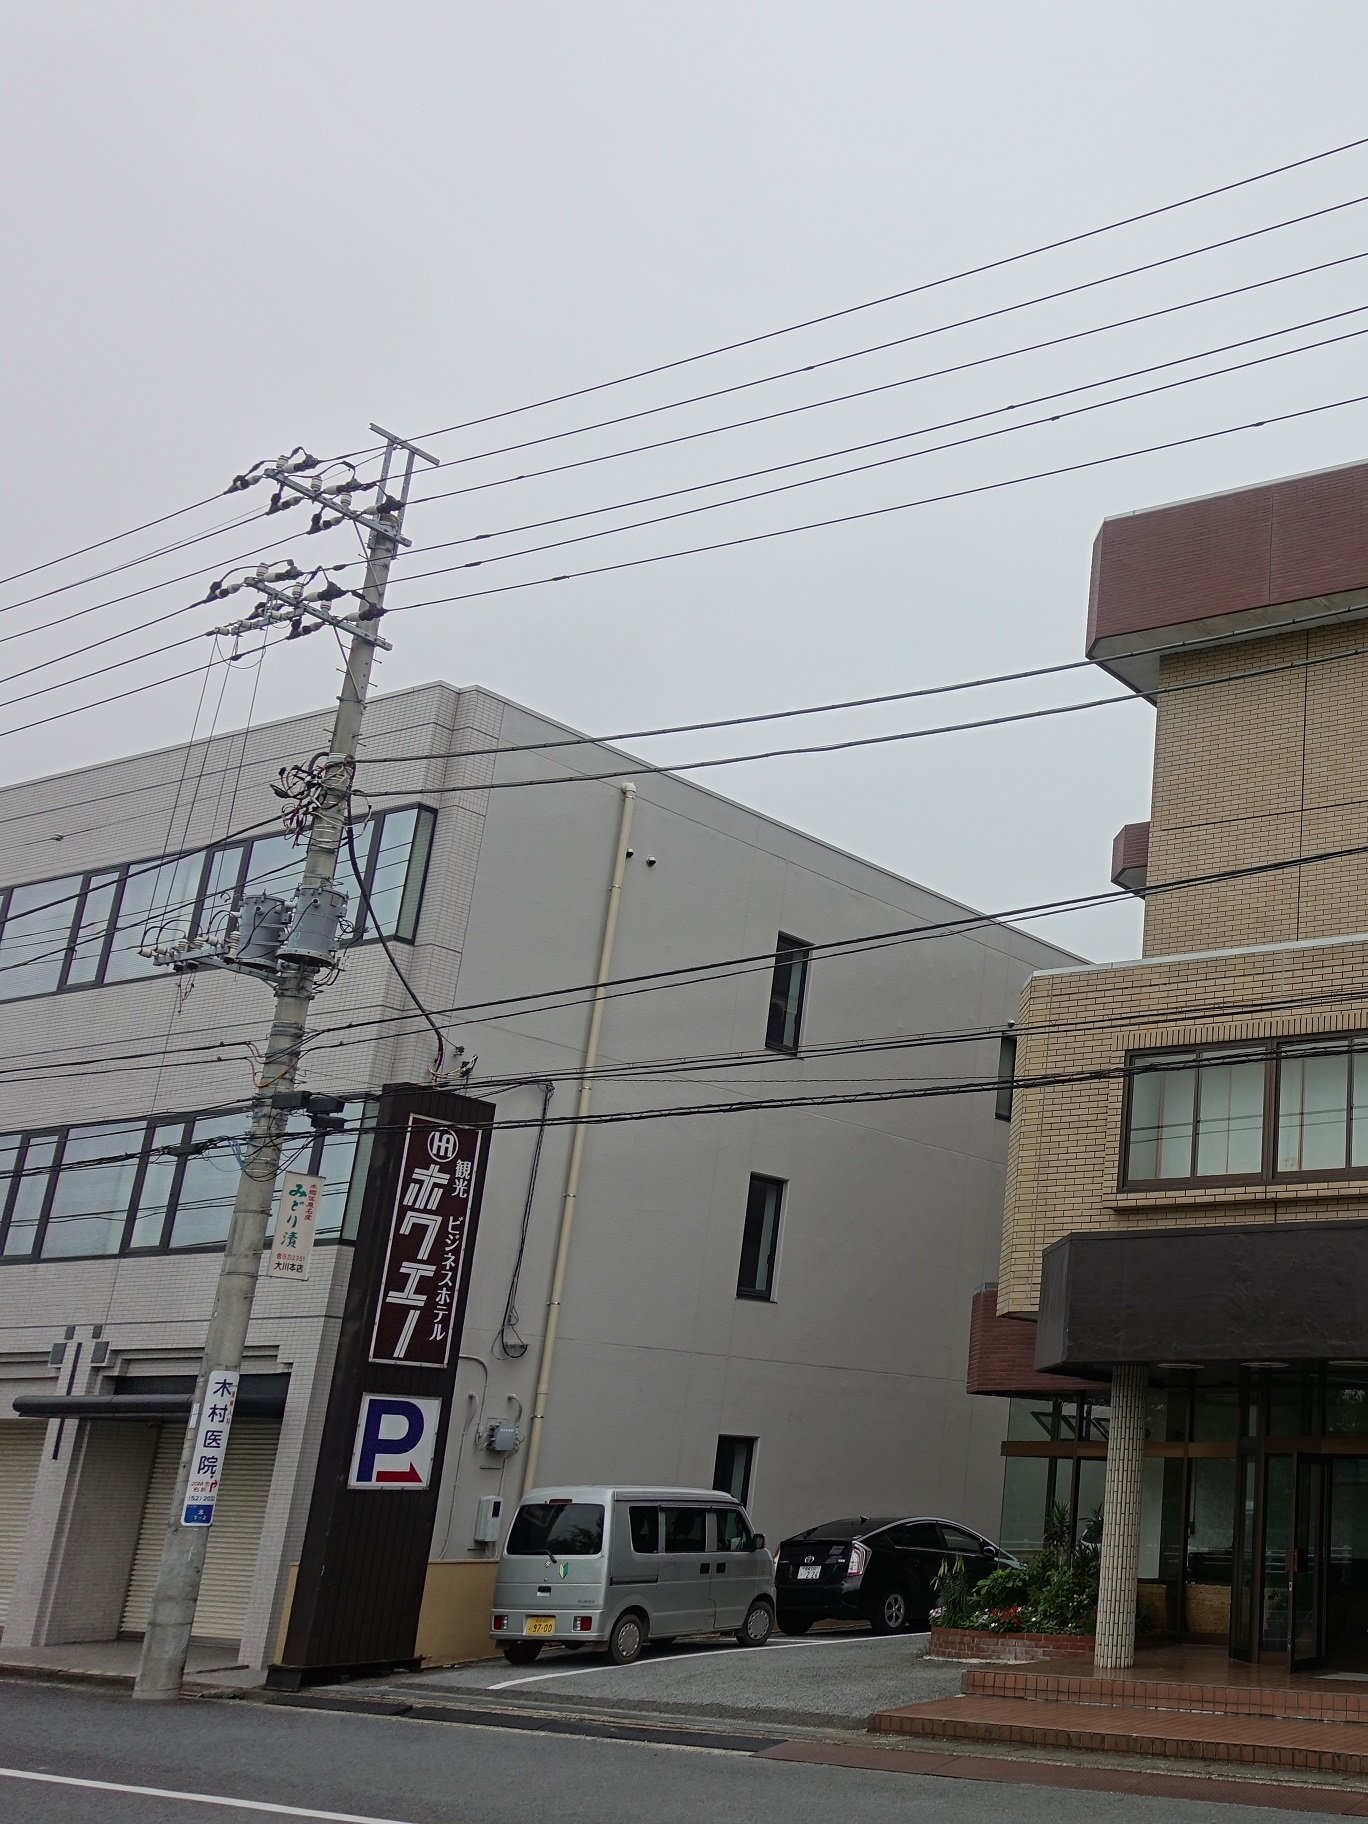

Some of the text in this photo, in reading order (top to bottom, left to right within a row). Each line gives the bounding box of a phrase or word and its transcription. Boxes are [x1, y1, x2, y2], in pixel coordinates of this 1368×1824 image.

[280, 1183, 307, 1249] みどり漬
[429, 1159, 472, 1341] 観光 ビジネスホテル
[274, 1262, 305, 1273] 大川本店
[386, 1164, 450, 1358] ホクエー
[197, 1379, 234, 1475] 木村医院
[356, 1399, 424, 1482] P
[532, 1624, 553, 1632] 97-00
